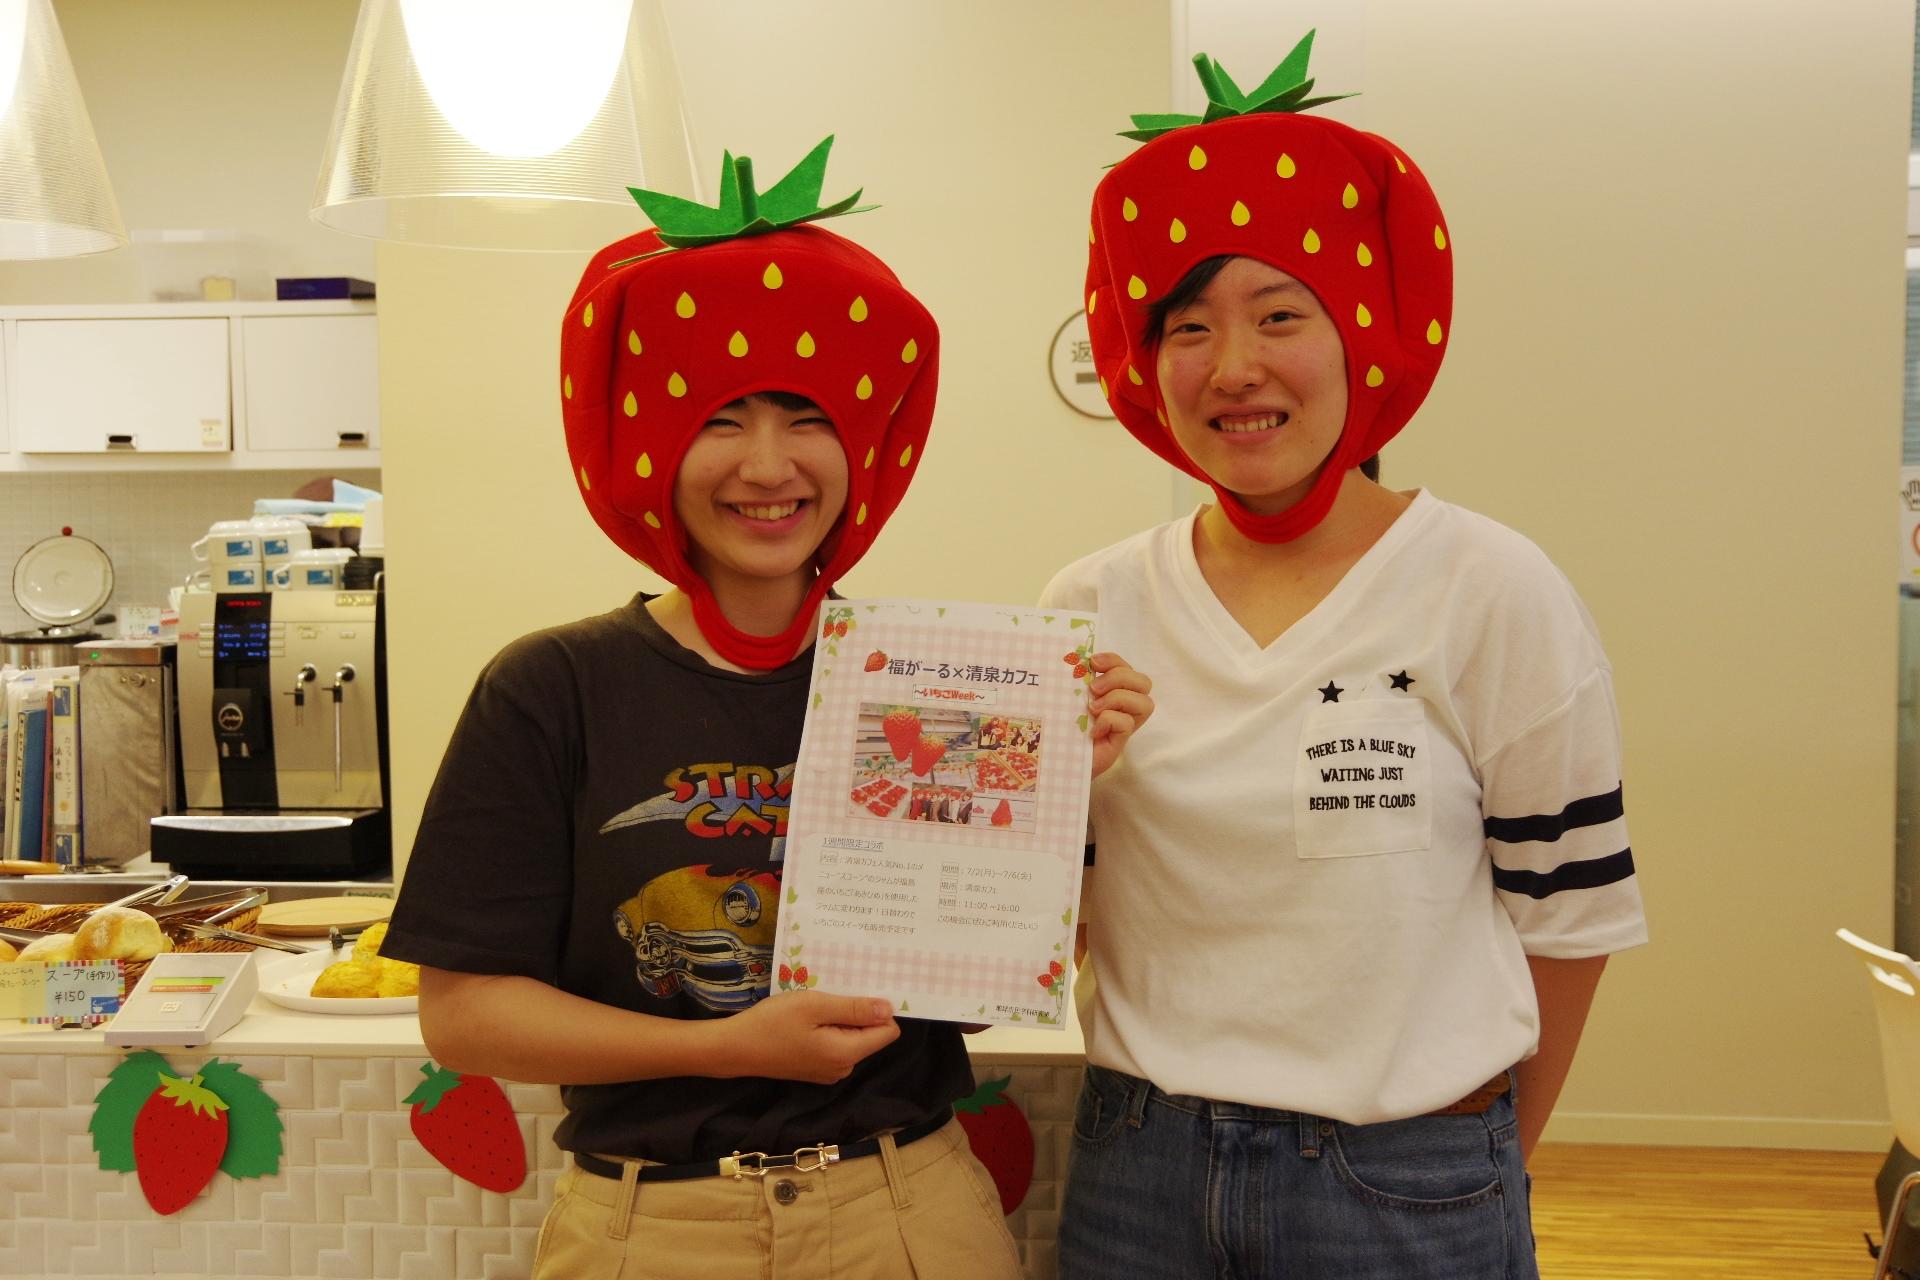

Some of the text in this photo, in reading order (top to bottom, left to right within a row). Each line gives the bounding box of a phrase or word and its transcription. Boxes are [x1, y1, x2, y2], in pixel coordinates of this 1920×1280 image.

[888, 658, 1040, 687] 福がーる×清泉カフェ
[1306, 738, 1416, 761] THERE IS A BLUE SKY
[1321, 767, 1404, 783] WAITING JUST
[1309, 794, 1416, 811] BEHIND THE CLOUDS
[54, 990, 86, 1005] ¥150
